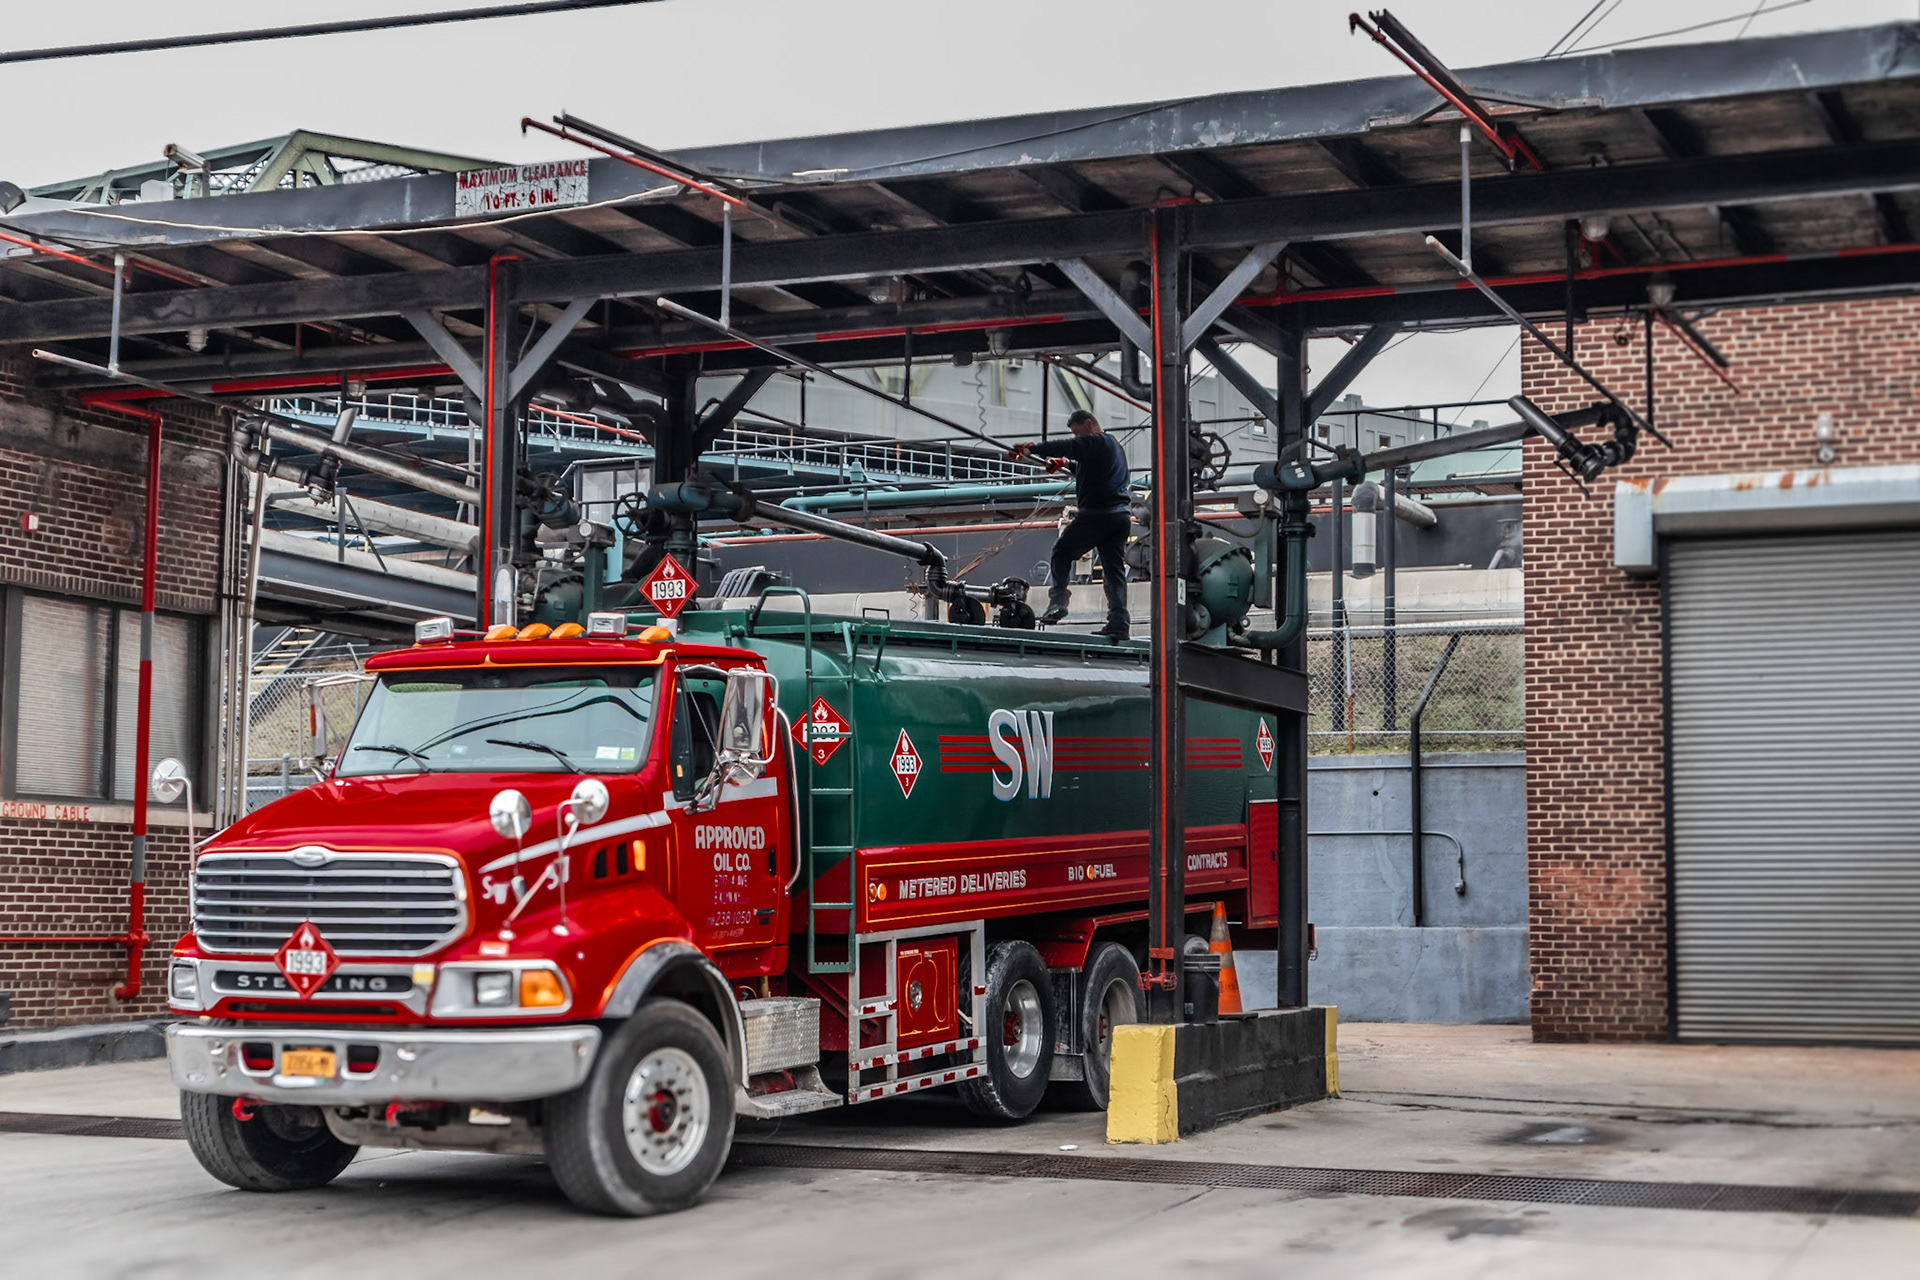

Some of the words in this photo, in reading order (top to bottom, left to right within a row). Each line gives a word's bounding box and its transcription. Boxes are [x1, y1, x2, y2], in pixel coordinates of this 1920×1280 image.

[458, 168, 518, 190] MAXIMUM
[522, 160, 586, 182] CLEARANCE
[485, 193, 500, 210] 10
[504, 192, 521, 208] FT.
[529, 190, 536, 205] 6
[541, 188, 558, 203] IN.
[653, 580, 683, 599] 1993
[666, 600, 672, 612] 3
[818, 749, 825, 760] 3
[898, 756, 915, 773] 1993
[988, 708, 1055, 802] SW
[2, 802, 47, 819] GROUND
[54, 804, 90, 822] CABLE
[695, 825, 766, 849] APPROVED
[713, 852, 733, 872] OIL
[735, 852, 752, 872] CO.
[1068, 865, 1084, 881] BIO
[1093, 863, 1117, 879] FUEL
[1187, 851, 1228, 871] CONTRACTS
[898, 875, 957, 900] METERED
[960, 868, 1027, 894] DELIVERIES
[288, 951, 325, 973] 1993
[237, 974, 388, 992] STEING
[302, 976, 310, 989] 3
